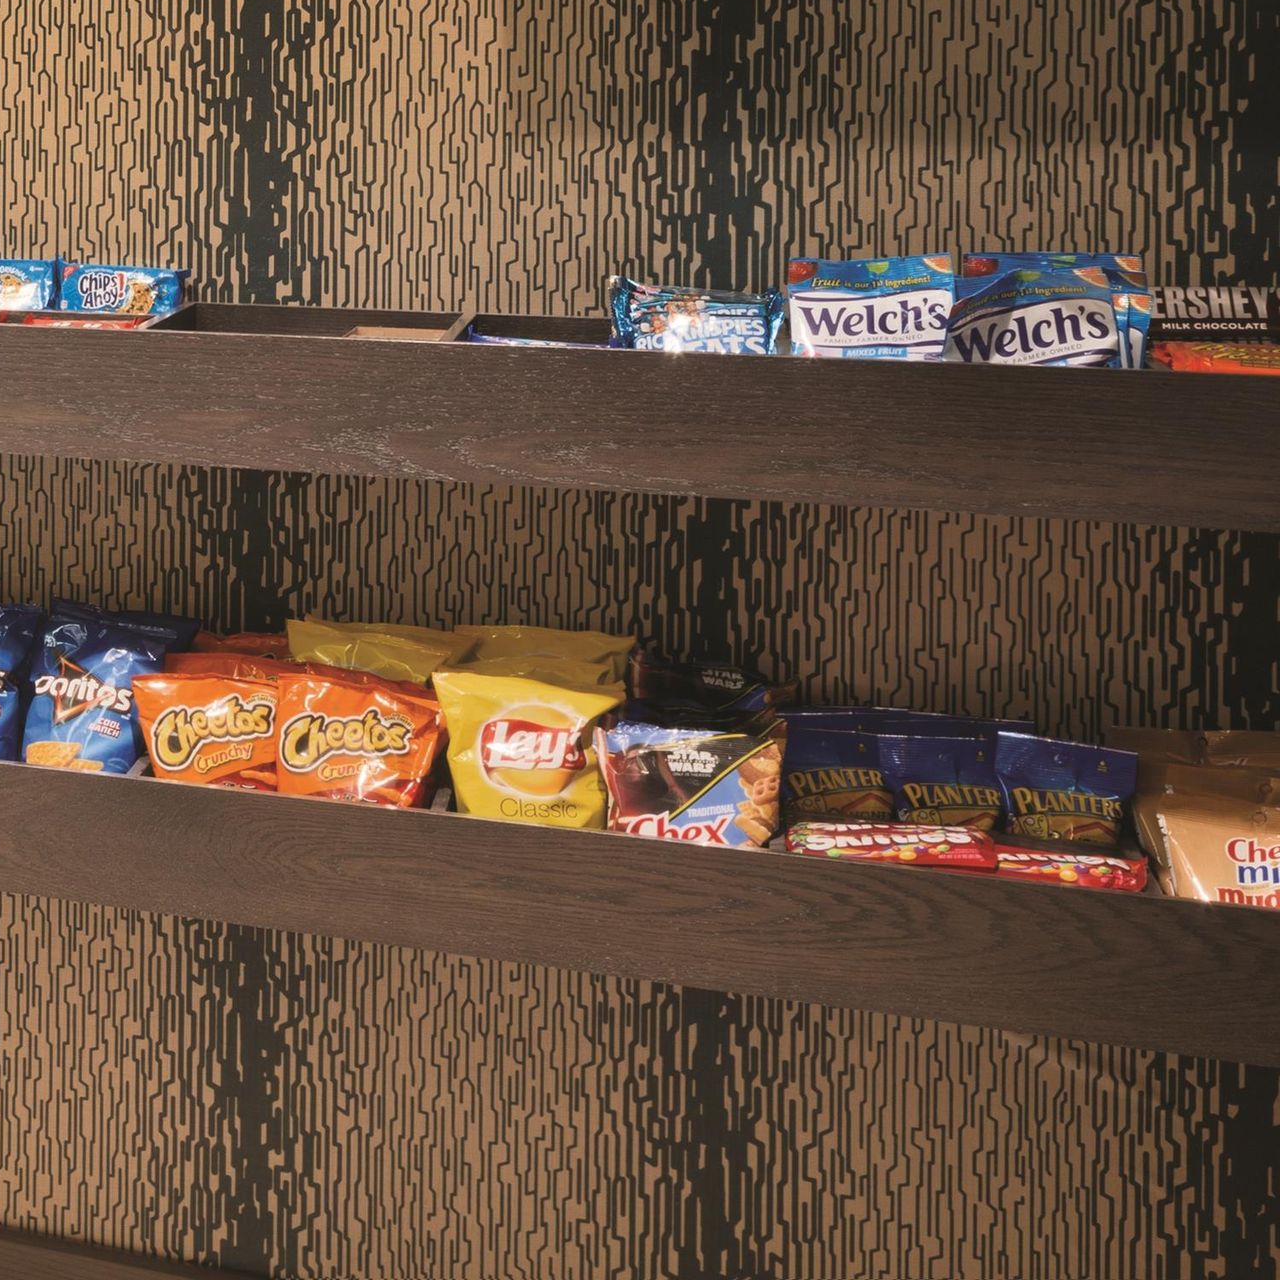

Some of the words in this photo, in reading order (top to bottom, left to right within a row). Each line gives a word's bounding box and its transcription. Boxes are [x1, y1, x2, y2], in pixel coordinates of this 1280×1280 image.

[80, 272, 117, 295] Chips
[812, 276, 841, 288] Fruit
[844, 280, 851, 288] is
[885, 275, 931, 289] Ingredient!
[1035, 285, 1088, 296] Ingredient!
[1150, 286, 1280, 319] ERSHEY'
[798, 297, 948, 337] Welch's
[1162, 322, 1191, 330] MILK
[1193, 322, 1268, 330] CHOCOLATE
[856, 335, 890, 343] FARMER
[892, 333, 923, 342] OWNED
[953, 305, 1110, 363] Welch's
[847, 349, 876, 357] MIXED
[878, 347, 904, 357] FRUIT
[1049, 343, 1083, 356] OWNED
[34, 675, 133, 712] Doritos
[88, 723, 121, 738] RANCH
[98, 719, 121, 730] COOL
[154, 695, 274, 768] Cheetos
[281, 708, 411, 770] Cheetos
[490, 718, 581, 769] Lay's
[195, 741, 253, 773] Crunchy
[667, 748, 715, 761] STAR
[667, 761, 716, 773] WARS
[790, 770, 884, 798] PLANTER
[903, 781, 1001, 810] PLANTER
[500, 797, 578, 819] Classic
[687, 803, 736, 818] TRADITIONAL
[1013, 785, 1123, 819] PLANTERS
[627, 811, 730, 845] Chex
